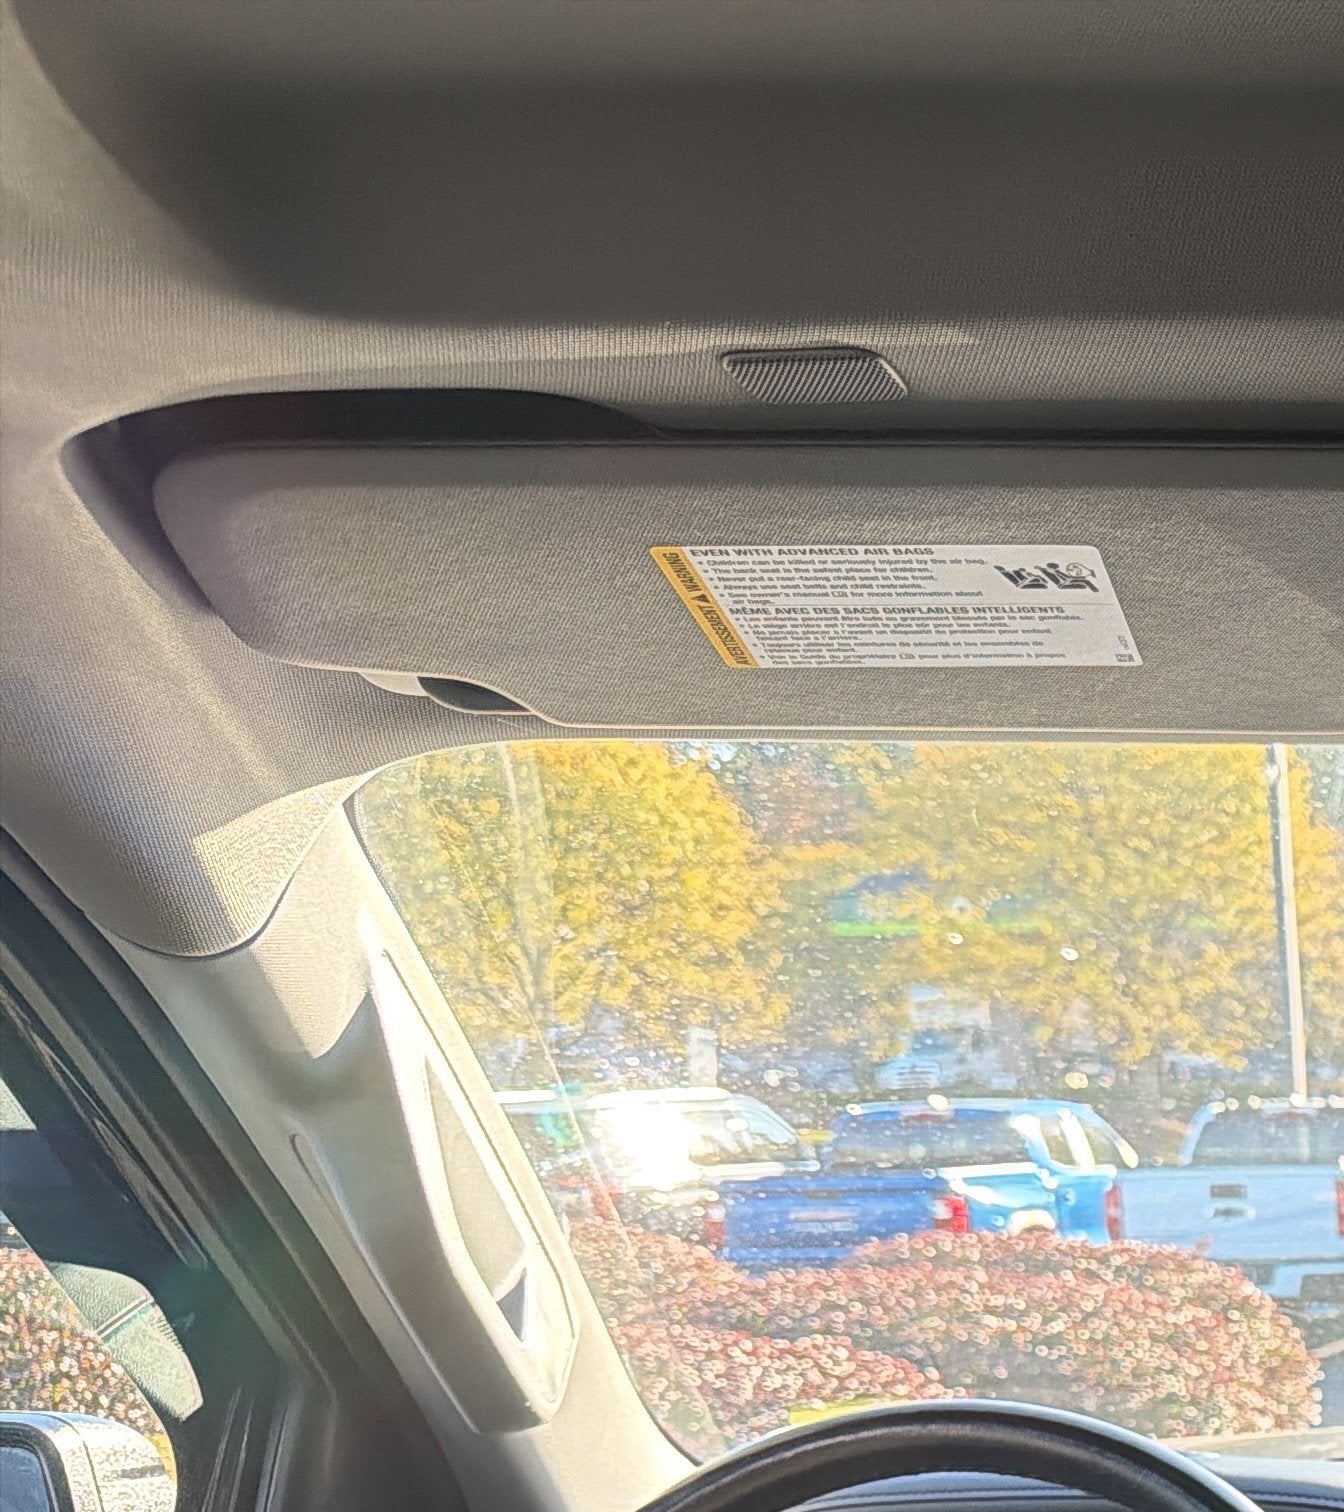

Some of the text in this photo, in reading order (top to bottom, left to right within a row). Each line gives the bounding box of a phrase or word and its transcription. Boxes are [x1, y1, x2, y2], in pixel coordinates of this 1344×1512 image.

[690, 548, 935, 557] EVEN WITH ADVANCED AIR BAGS
[662, 552, 702, 592] WARNING
[728, 606, 1065, 615] MÊME AVEC DES SACS GONFLABLES INTELLIGENTS
